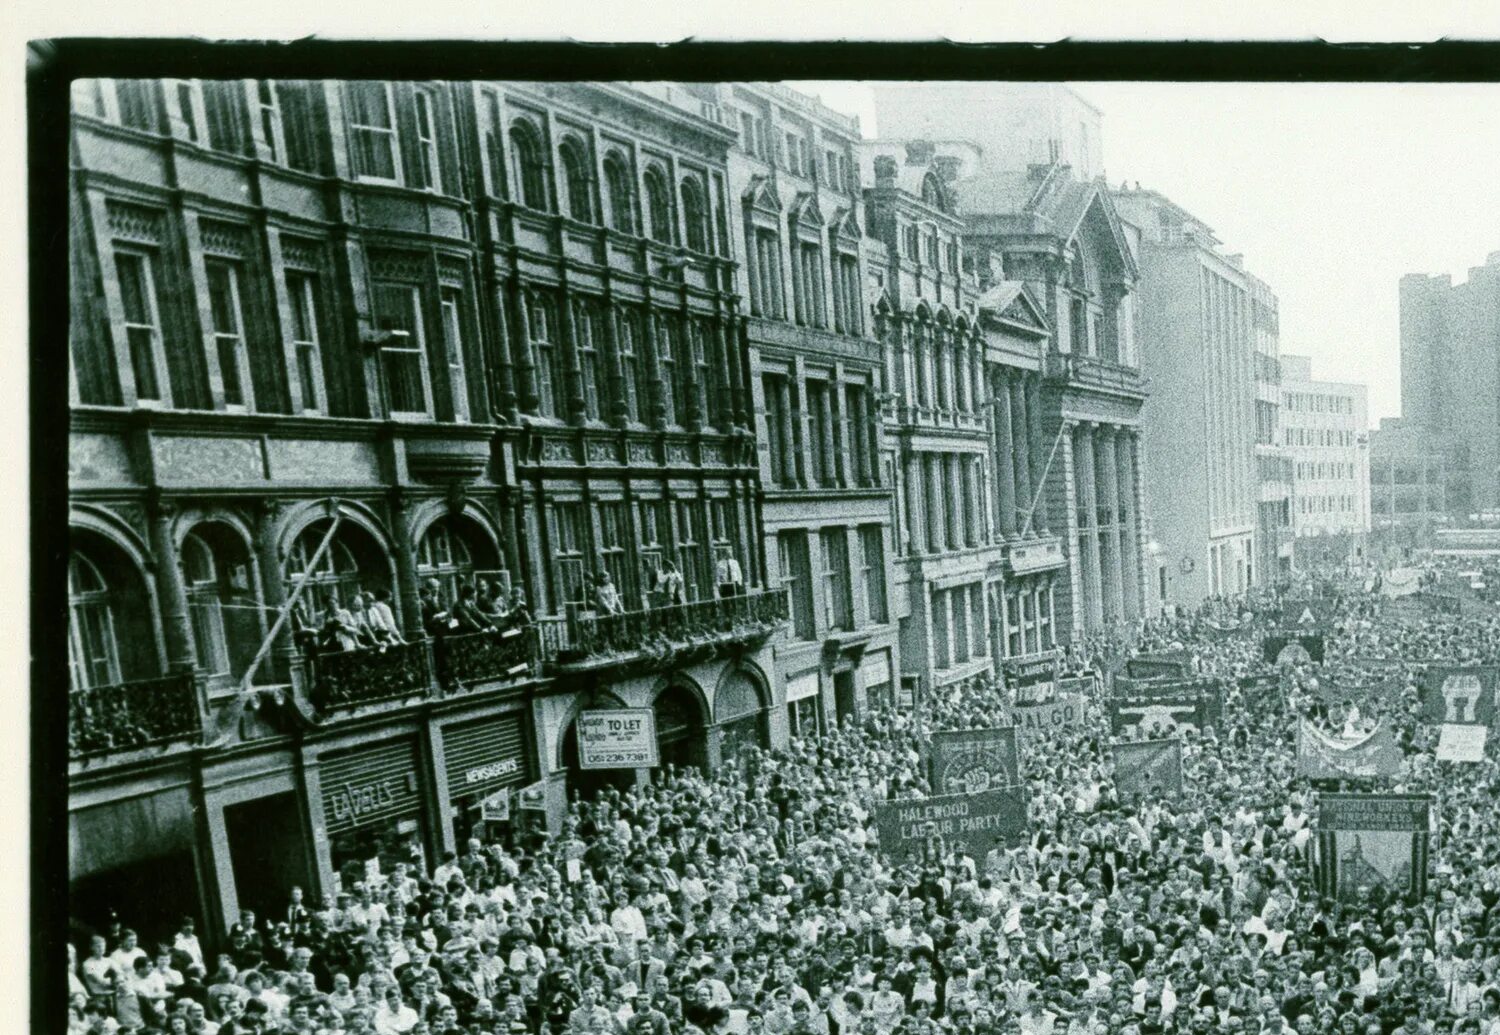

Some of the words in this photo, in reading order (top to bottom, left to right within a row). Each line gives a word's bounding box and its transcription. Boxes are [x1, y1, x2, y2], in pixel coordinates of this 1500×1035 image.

[607, 720, 622, 731] TO
[623, 720, 641, 730] LET
[1012, 705, 1074, 729] NALGO
[900, 802, 969, 822] HALEWOOD
[960, 813, 1000, 832] PARTY
